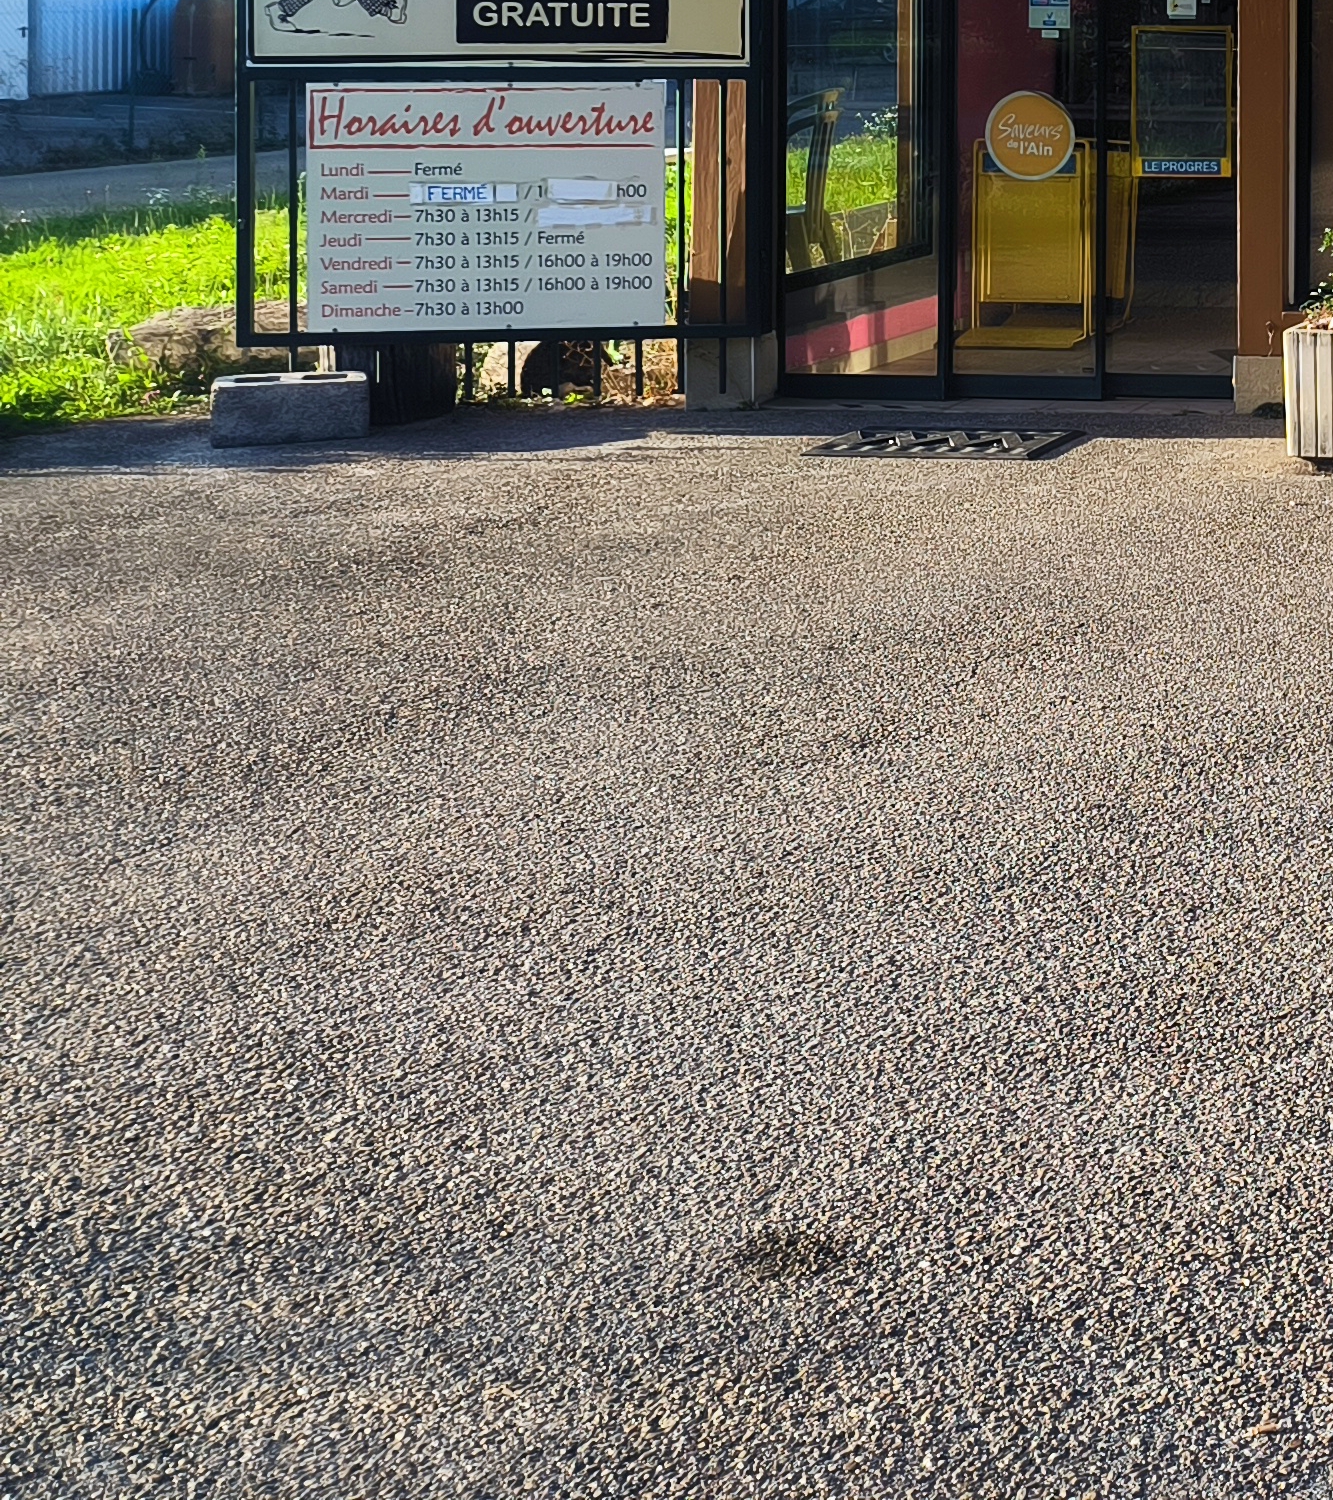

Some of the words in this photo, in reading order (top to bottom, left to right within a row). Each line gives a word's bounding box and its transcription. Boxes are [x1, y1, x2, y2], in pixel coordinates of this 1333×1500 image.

[473, 1, 651, 28] GRATUITE
[318, 96, 461, 137] Horaires
[472, 96, 655, 135] d'ouverture
[997, 113, 1063, 141] Saveurs
[1006, 139, 1019, 149] de
[1019, 141, 1053, 157] l'Ain
[320, 163, 365, 178] Lundi
[414, 162, 463, 176] Fermé
[1144, 161, 1160, 172] LE
[320, 186, 369, 201] Mardi
[427, 184, 488, 201] FERMÉ
[320, 210, 393, 225] Mercredi
[415, 209, 456, 223] 7h30
[461, 209, 470, 223] à
[475, 209, 519, 223] 13h15
[320, 233, 363, 248] Jeudi
[415, 232, 456, 247] 7h30
[461, 232, 470, 247] à
[475, 231, 519, 247] 13h15
[537, 231, 585, 246] Fermé
[320, 257, 393, 271] Vendredi
[415, 254, 456, 269] 7h30
[461, 254, 470, 269] à
[475, 254, 519, 269] 13h15
[537, 253, 586, 268] 16h00
[590, 253, 599, 268] à
[604, 252, 653, 267] 19h00
[320, 280, 379, 295] Samedi
[415, 279, 456, 293] 7h30
[461, 278, 470, 293] à
[475, 278, 519, 293] 13h15
[537, 276, 586, 291] 16h00
[590, 276, 599, 291] à
[604, 275, 653, 290] 19h00
[320, 303, 402, 318] Dimanche
[415, 302, 456, 317] 7h30
[461, 301, 470, 317] à
[475, 301, 524, 316] 13h00
